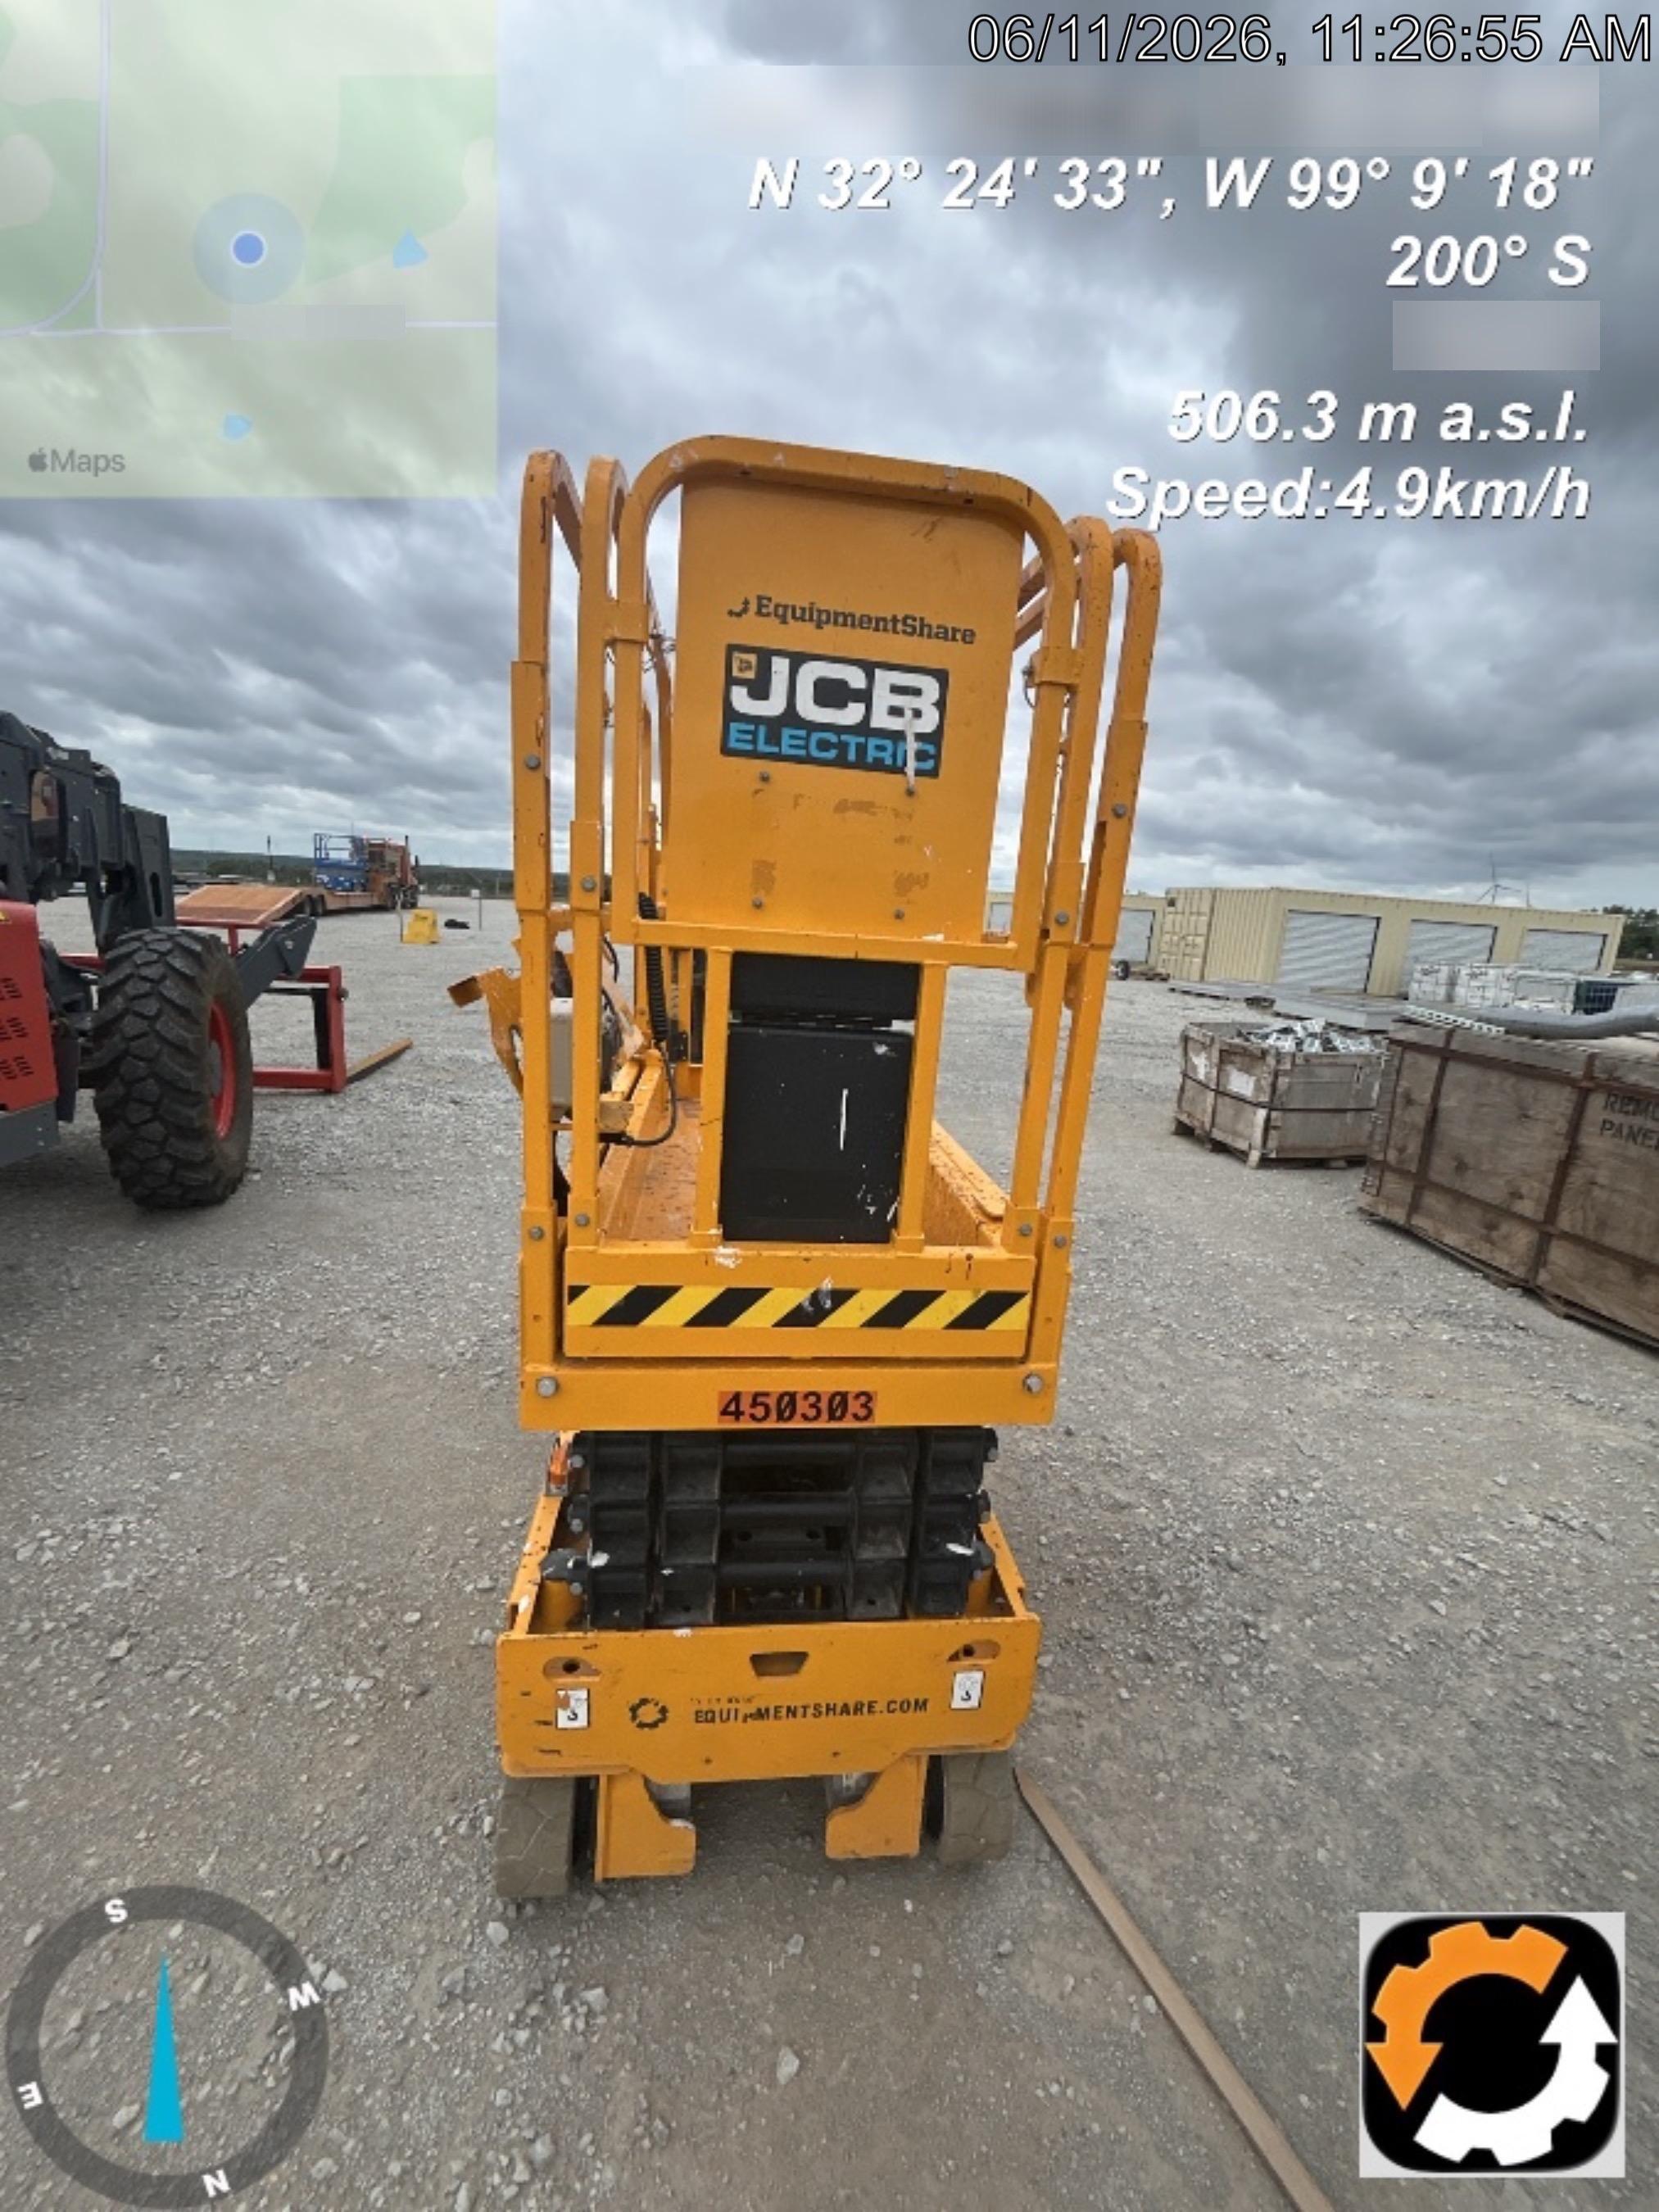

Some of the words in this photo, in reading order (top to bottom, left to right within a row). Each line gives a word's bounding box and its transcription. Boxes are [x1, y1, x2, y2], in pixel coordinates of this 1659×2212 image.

[755, 594, 976, 645] EquipmentShare
[729, 655, 941, 734] JCB
[728, 722, 937, 771] ELECTRIC
[719, 1390, 874, 1423] 450303
